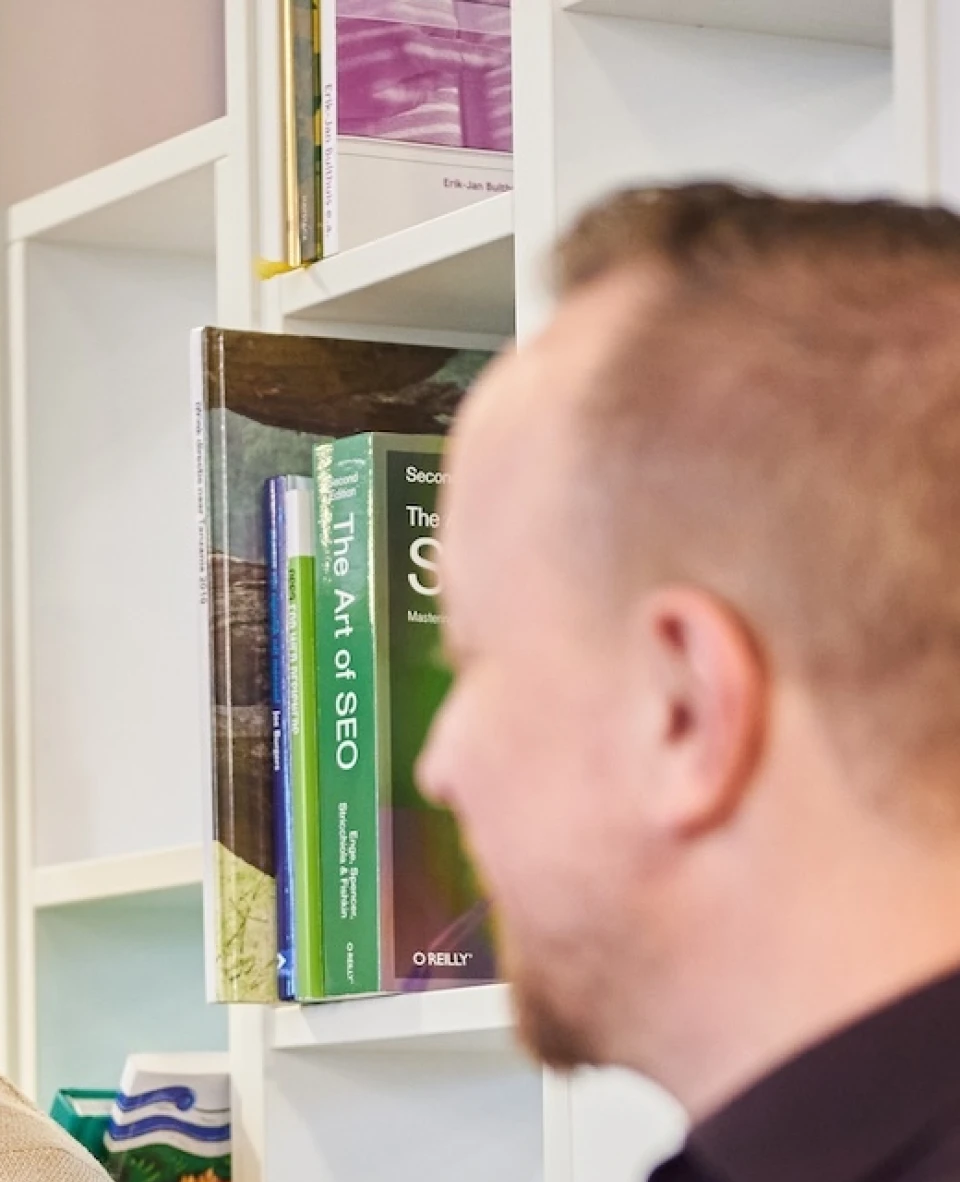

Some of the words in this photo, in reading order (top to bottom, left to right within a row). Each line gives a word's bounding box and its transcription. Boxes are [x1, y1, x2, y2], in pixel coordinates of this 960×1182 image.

[442, 177, 483, 191] Erik-Jan
[406, 505, 440, 529] The
[333, 512, 355, 577] The
[334, 588, 356, 639] Art
[334, 649, 357, 680] of
[335, 691, 359, 771] SEO
[339, 866, 348, 876] &
[340, 878, 349, 918] Fishkin
